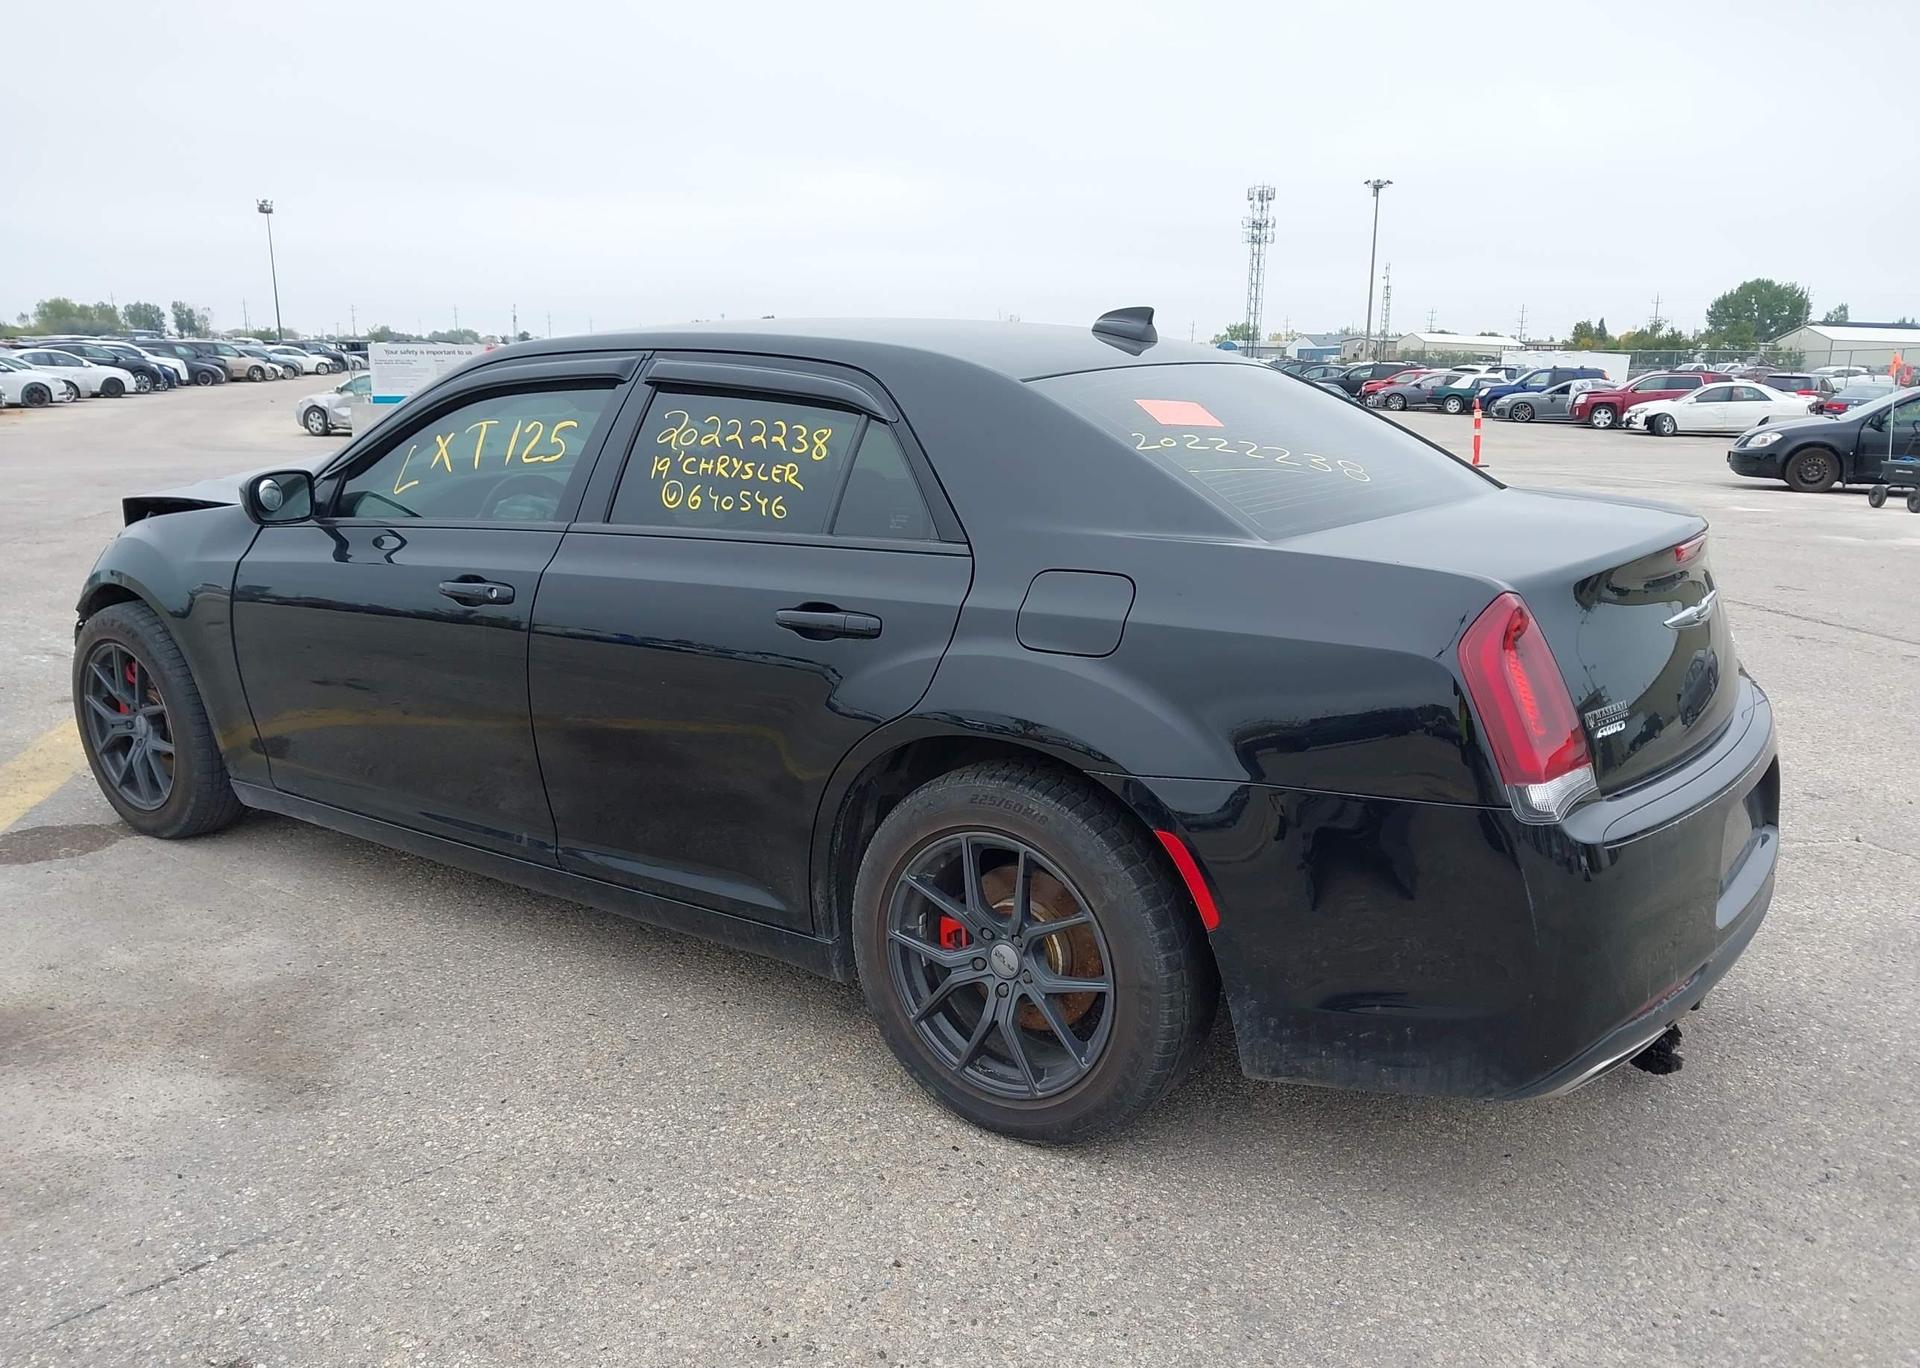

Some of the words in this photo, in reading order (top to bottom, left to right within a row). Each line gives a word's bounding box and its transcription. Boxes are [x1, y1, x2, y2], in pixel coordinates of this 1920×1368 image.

[400, 348, 418, 356] safety
[426, 348, 456, 356] important
[656, 410, 832, 460] 20222238
[1131, 432, 1371, 482] 20222238
[1596, 720, 1626, 738] AWD
